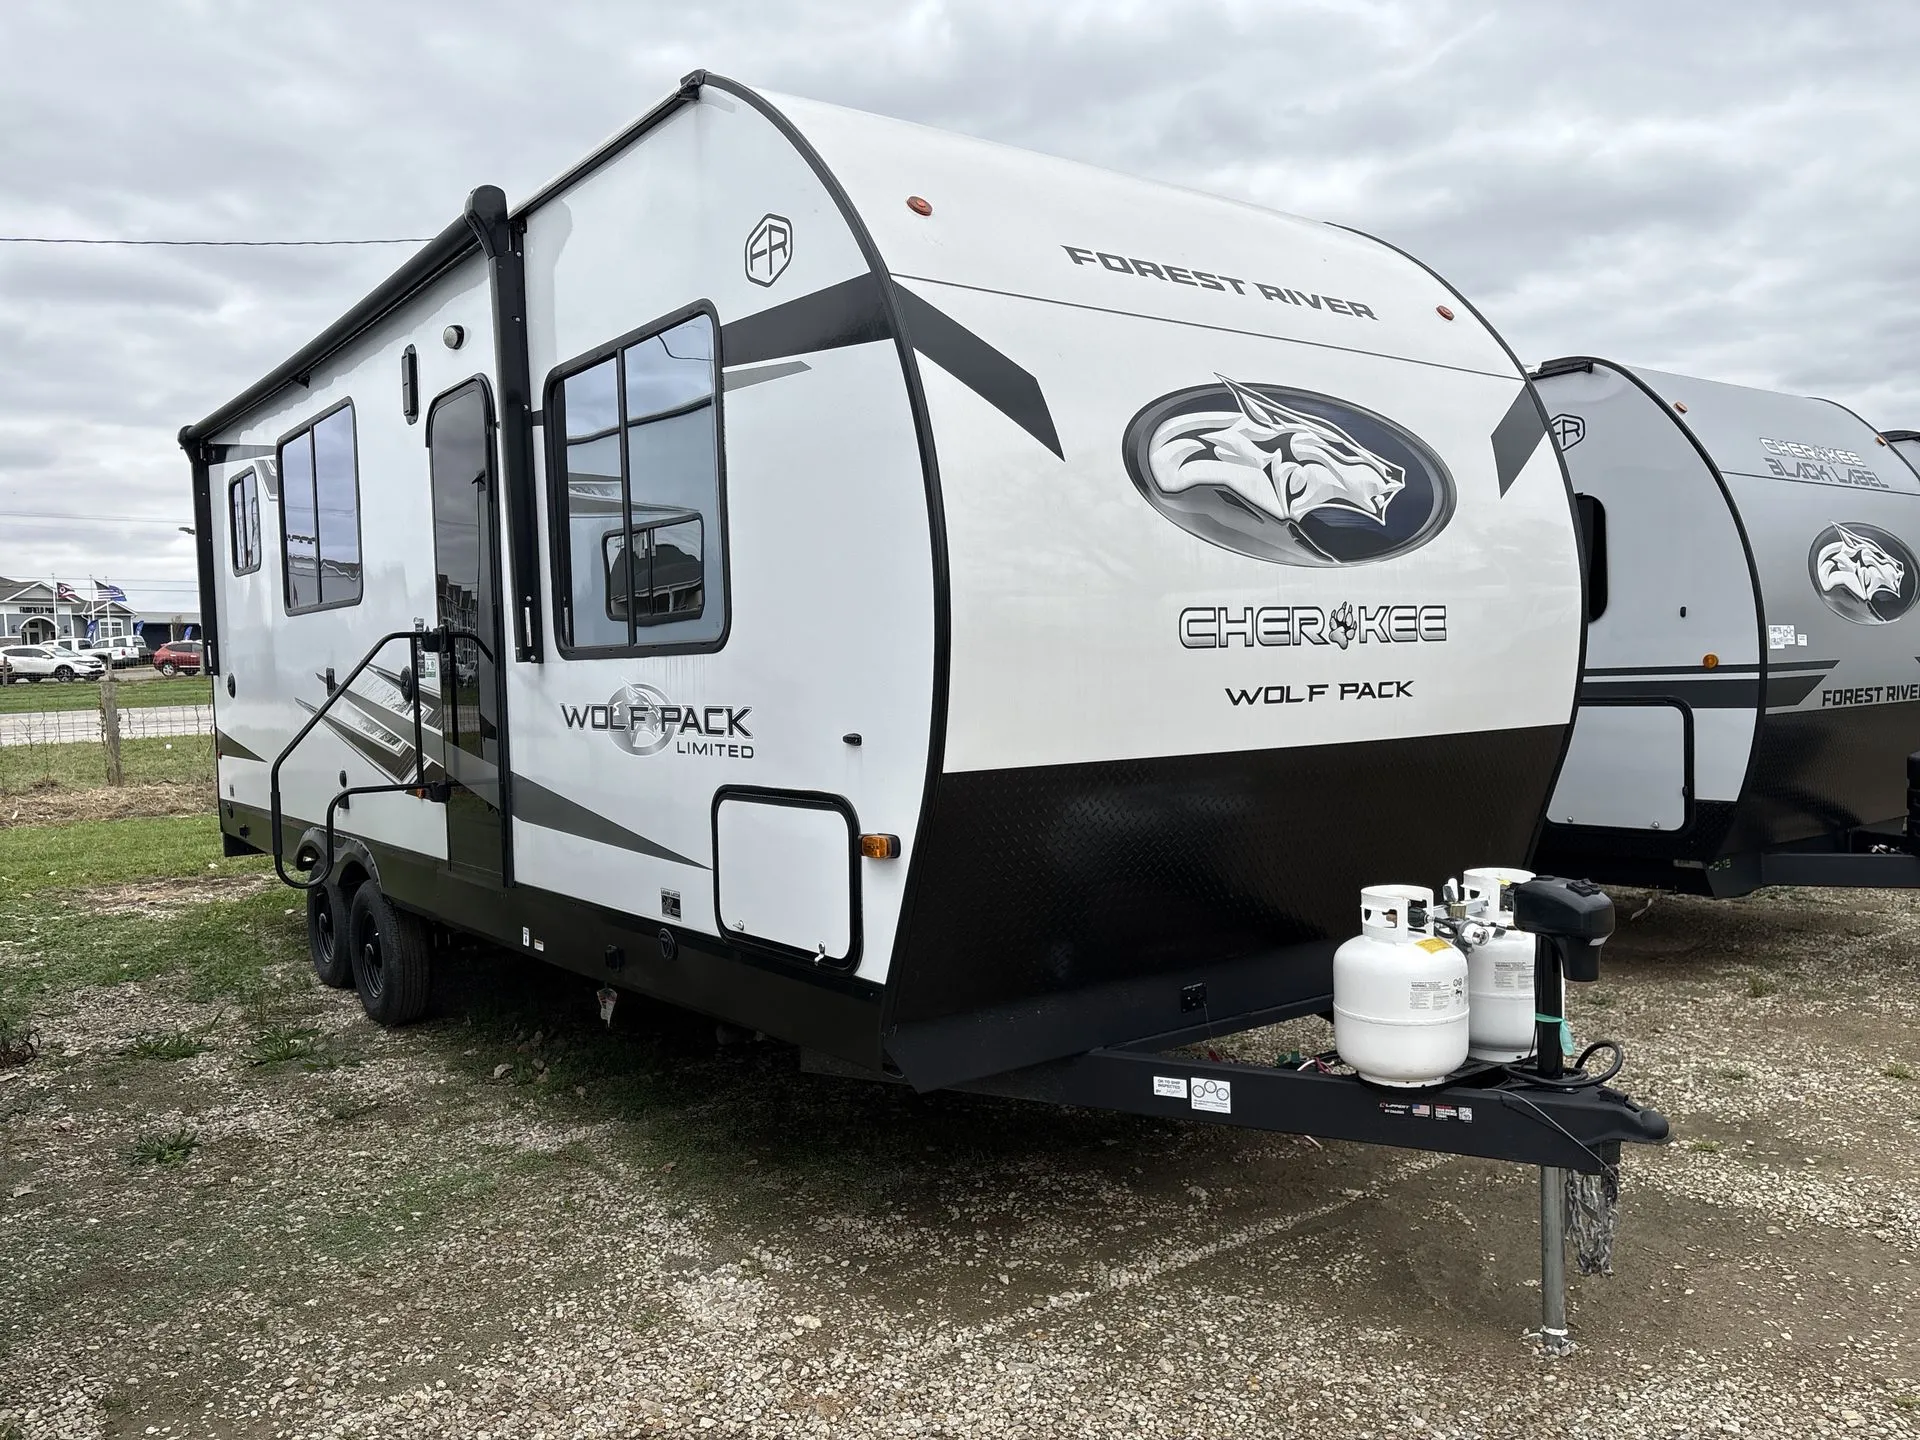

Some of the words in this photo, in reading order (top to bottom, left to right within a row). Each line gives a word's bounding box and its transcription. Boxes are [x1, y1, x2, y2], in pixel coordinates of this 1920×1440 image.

[1059, 244, 1247, 297] FOREST
[1252, 281, 1380, 322] RIVER
[1763, 456, 1833, 483] BLACK
[1829, 465, 1890, 489] LABEL
[1224, 684, 1330, 707] WOLF
[1338, 680, 1415, 702] PACK
[1821, 686, 1884, 707] FOREST
[1886, 683, 1920, 703] RIVE
[560, 702, 650, 732] WOLF
[655, 703, 754, 739] PACK
[676, 740, 755, 760] LIMITED
